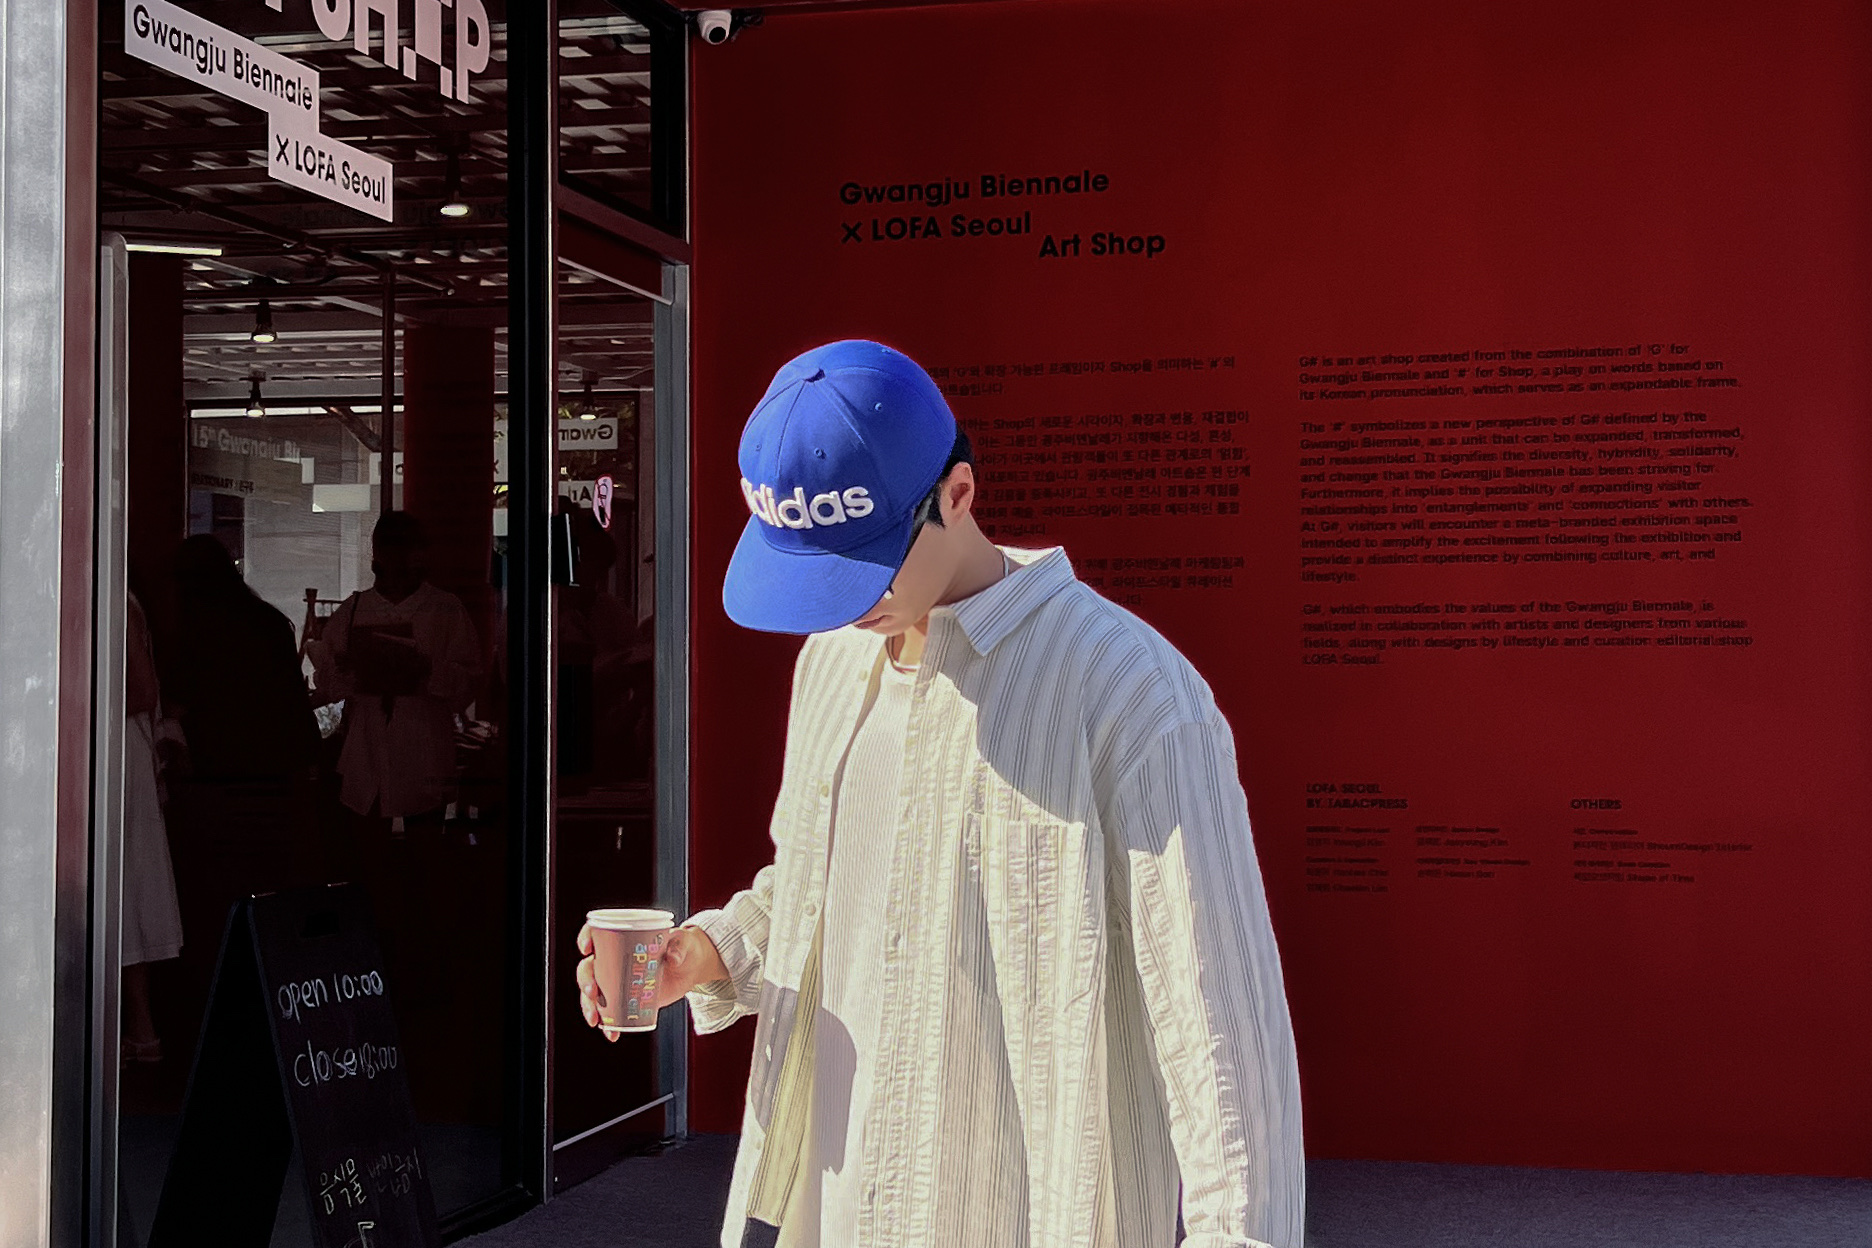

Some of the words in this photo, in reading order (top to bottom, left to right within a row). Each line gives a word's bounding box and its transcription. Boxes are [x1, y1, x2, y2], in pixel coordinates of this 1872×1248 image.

[133, 4, 226, 75] Gwangju
[233, 47, 313, 110] Biennale
[295, 140, 336, 185] LOFA
[342, 161, 386, 204] Seoul
[839, 176, 970, 207] Gwangju
[980, 170, 1109, 198] Biennale
[871, 216, 942, 241] LOFA
[950, 210, 1031, 237] Seoul
[1039, 234, 1081, 259] Art
[1091, 231, 1166, 259] Shop
[278, 978, 328, 1024] open
[333, 970, 384, 1004] 10:00
